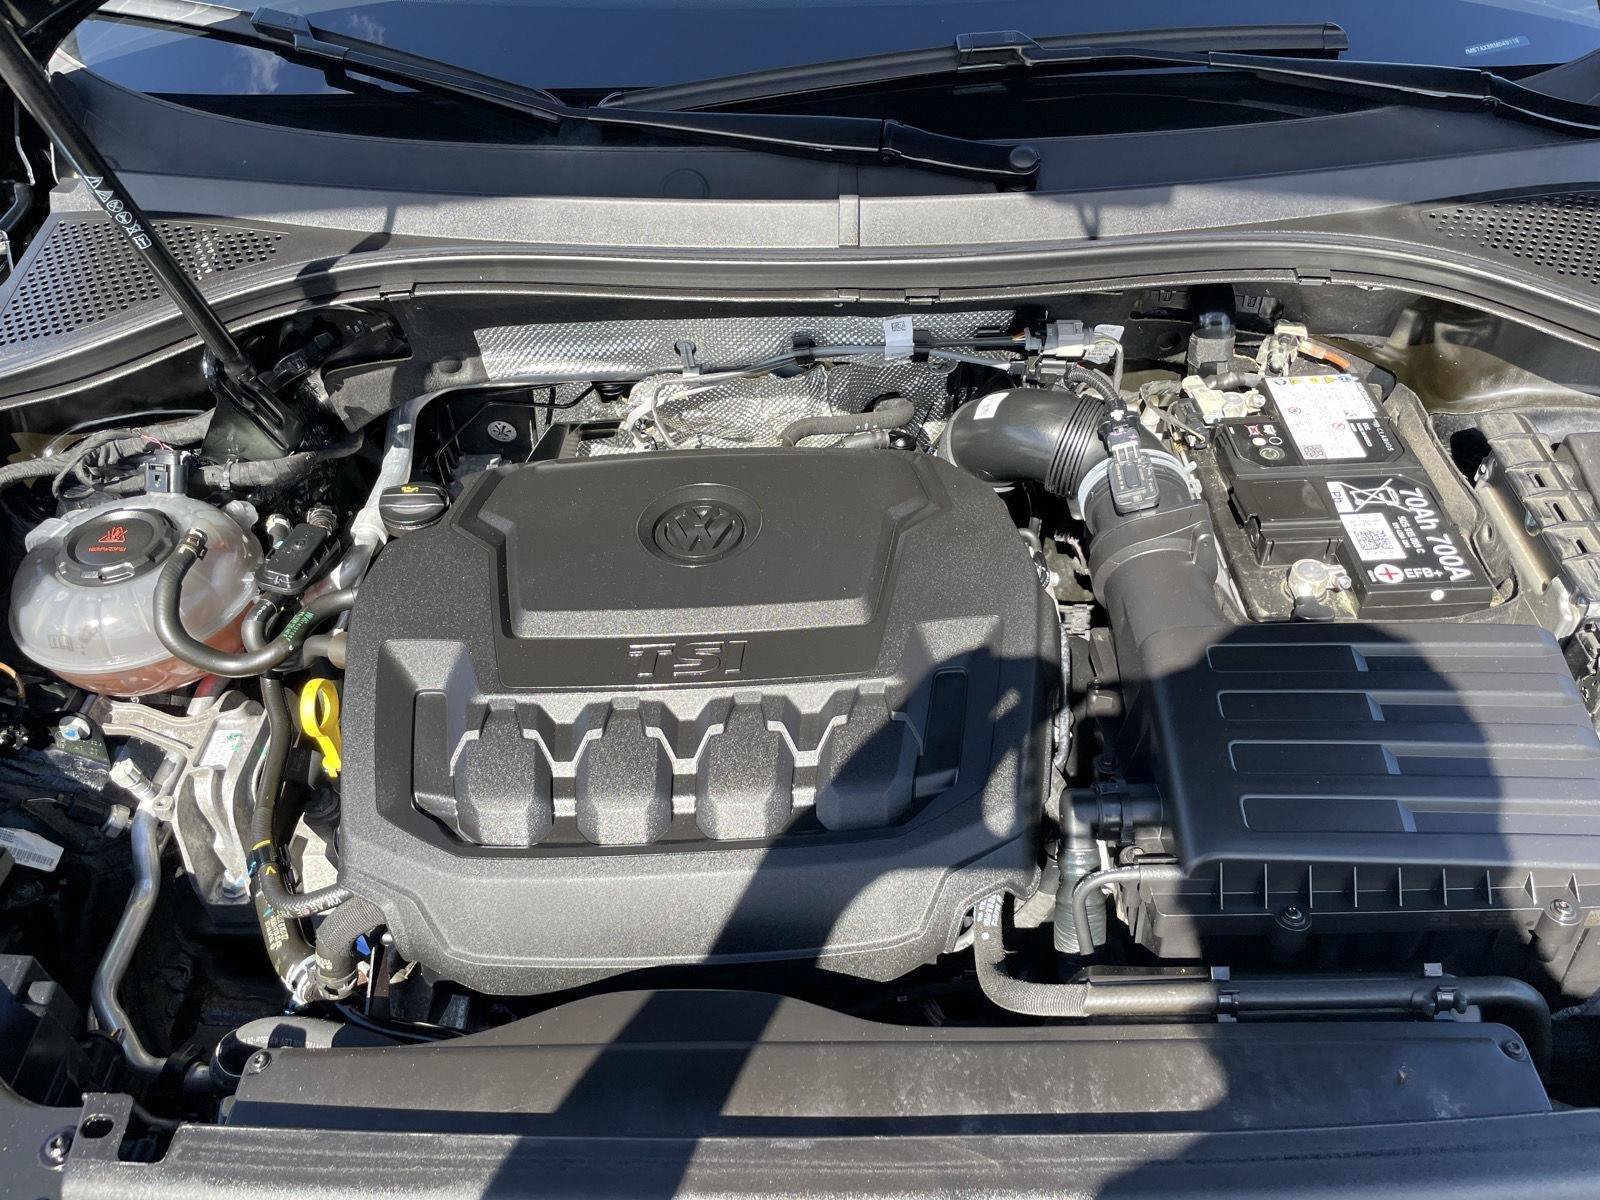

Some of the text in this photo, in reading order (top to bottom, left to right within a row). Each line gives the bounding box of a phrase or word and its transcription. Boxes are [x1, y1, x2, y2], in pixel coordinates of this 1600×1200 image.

[1376, 427, 1395, 452] CLARIOS
[1399, 487, 1471, 581] 70Ah 700A
[1404, 567, 1443, 579] EFB+
[629, 640, 748, 678] TSI
